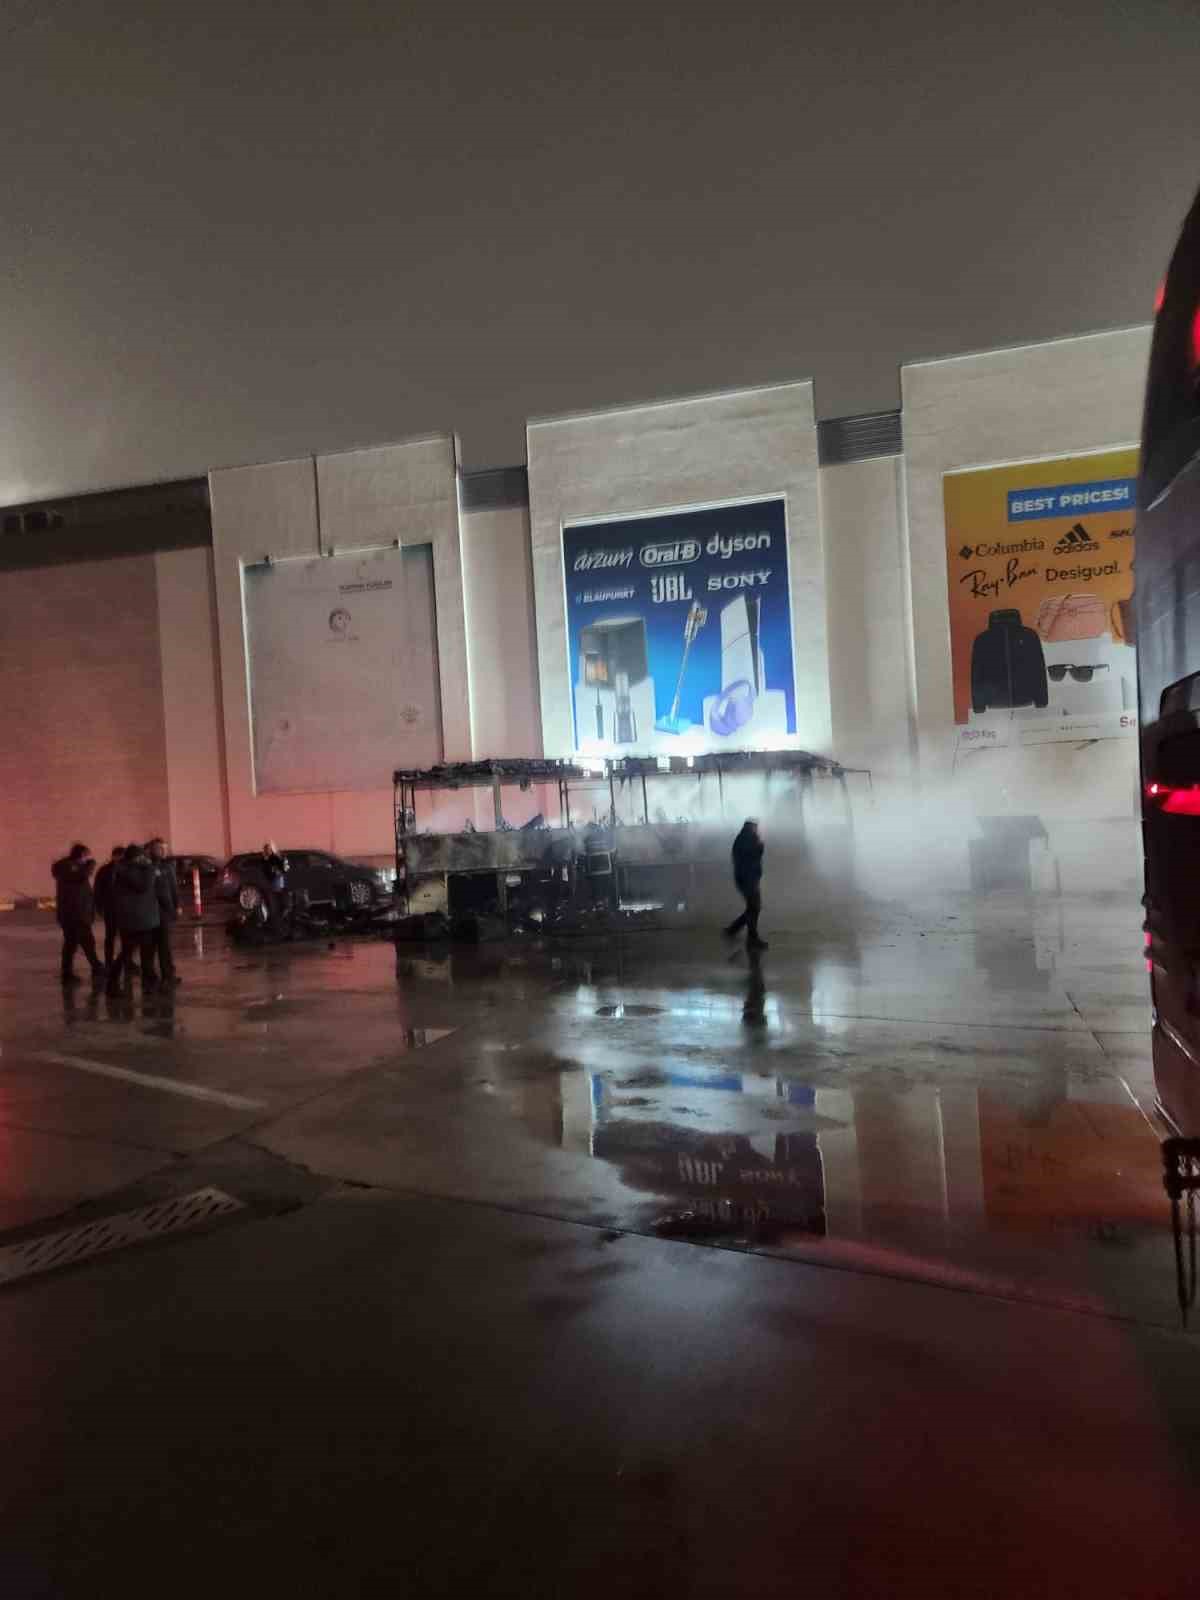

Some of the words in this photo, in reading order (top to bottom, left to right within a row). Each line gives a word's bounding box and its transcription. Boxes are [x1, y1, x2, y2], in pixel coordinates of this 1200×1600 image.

[1011, 497, 1054, 513] BEST
[1060, 486, 1129, 507] PRICES!
[574, 548, 634, 570] arzum
[644, 544, 696, 564] Oral-B
[706, 533, 771, 558] dyson
[975, 538, 1045, 557] Columbia
[1053, 541, 1100, 555] adidas
[650, 573, 692, 603] JBL
[708, 570, 771, 591] SONY
